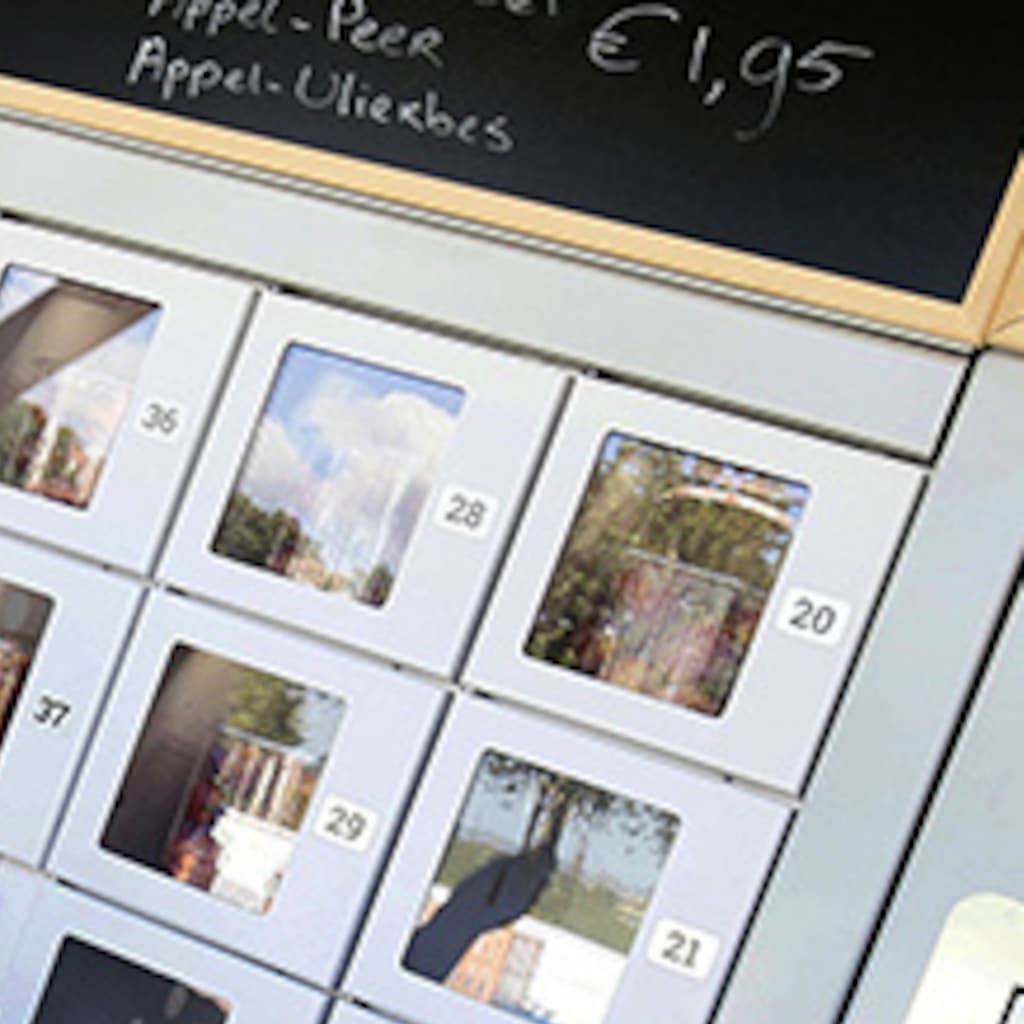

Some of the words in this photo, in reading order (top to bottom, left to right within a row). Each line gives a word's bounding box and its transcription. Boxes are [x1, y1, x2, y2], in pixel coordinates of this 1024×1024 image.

[141, 403, 178, 435] 36
[444, 494, 487, 529] 28
[790, 597, 836, 635] 20
[33, 695, 70, 727] 37
[325, 806, 367, 841] 29
[662, 930, 701, 967] 21
